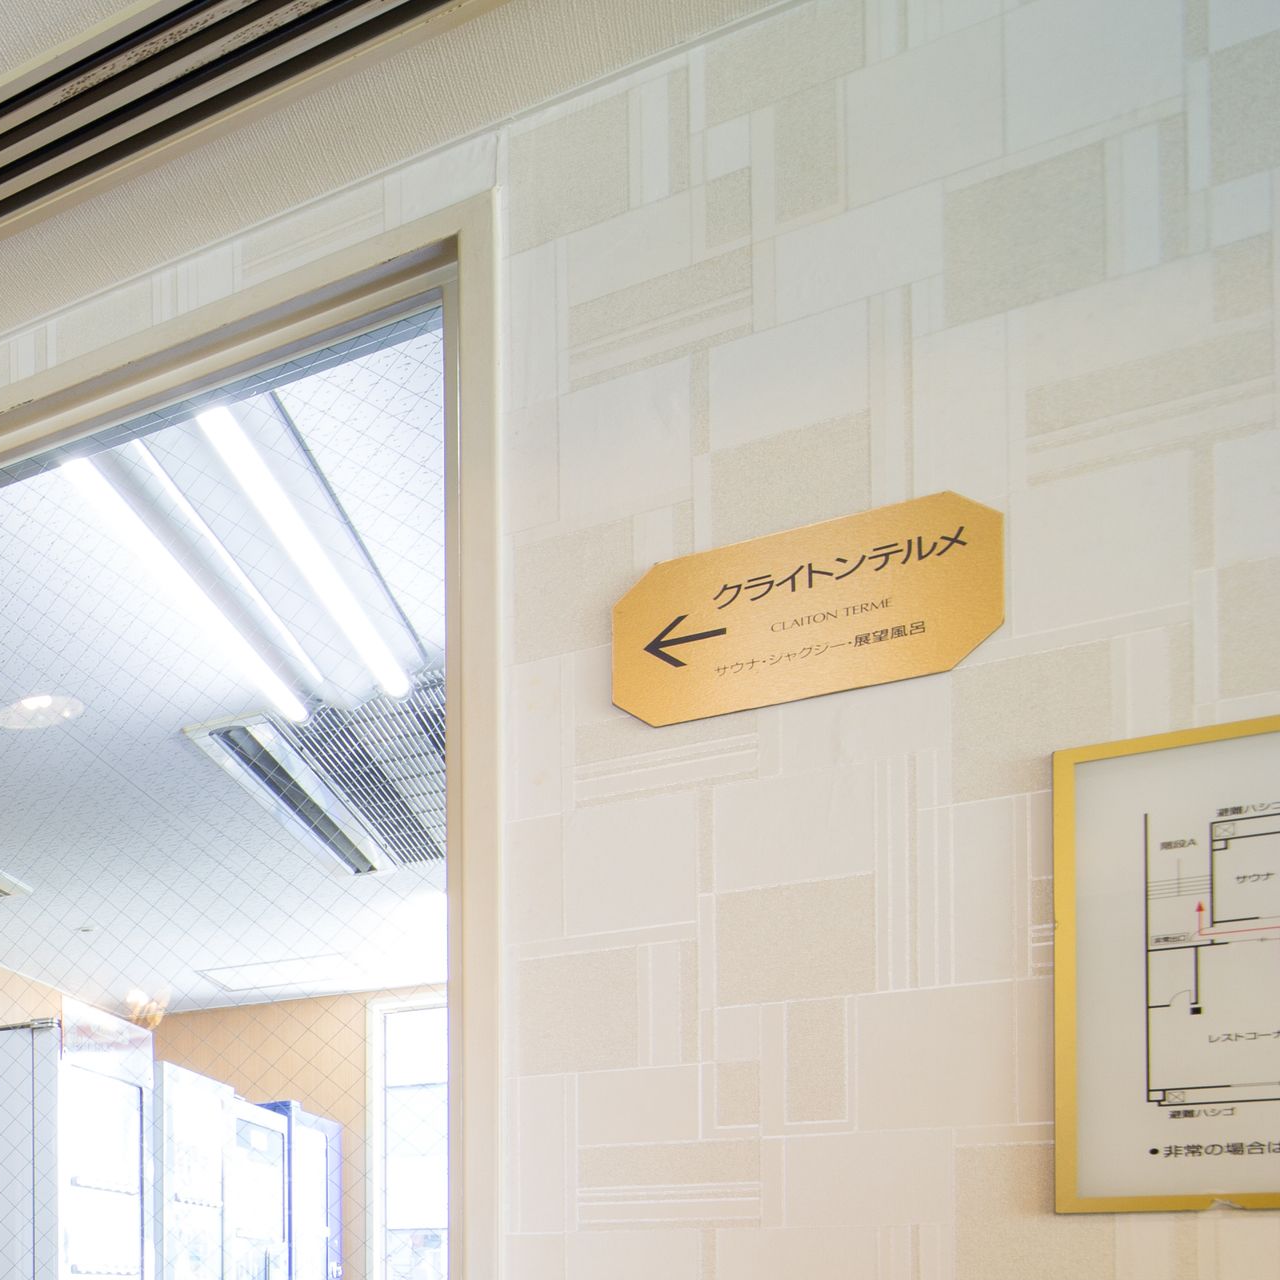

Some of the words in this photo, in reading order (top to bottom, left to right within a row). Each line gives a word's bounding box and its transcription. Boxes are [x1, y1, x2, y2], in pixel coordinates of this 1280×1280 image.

[712, 525, 968, 610] クライトンテルメ
[770, 609, 839, 633] CLAITON
[843, 597, 894, 617] TERME
[1236, 872, 1275, 884] サウナ
